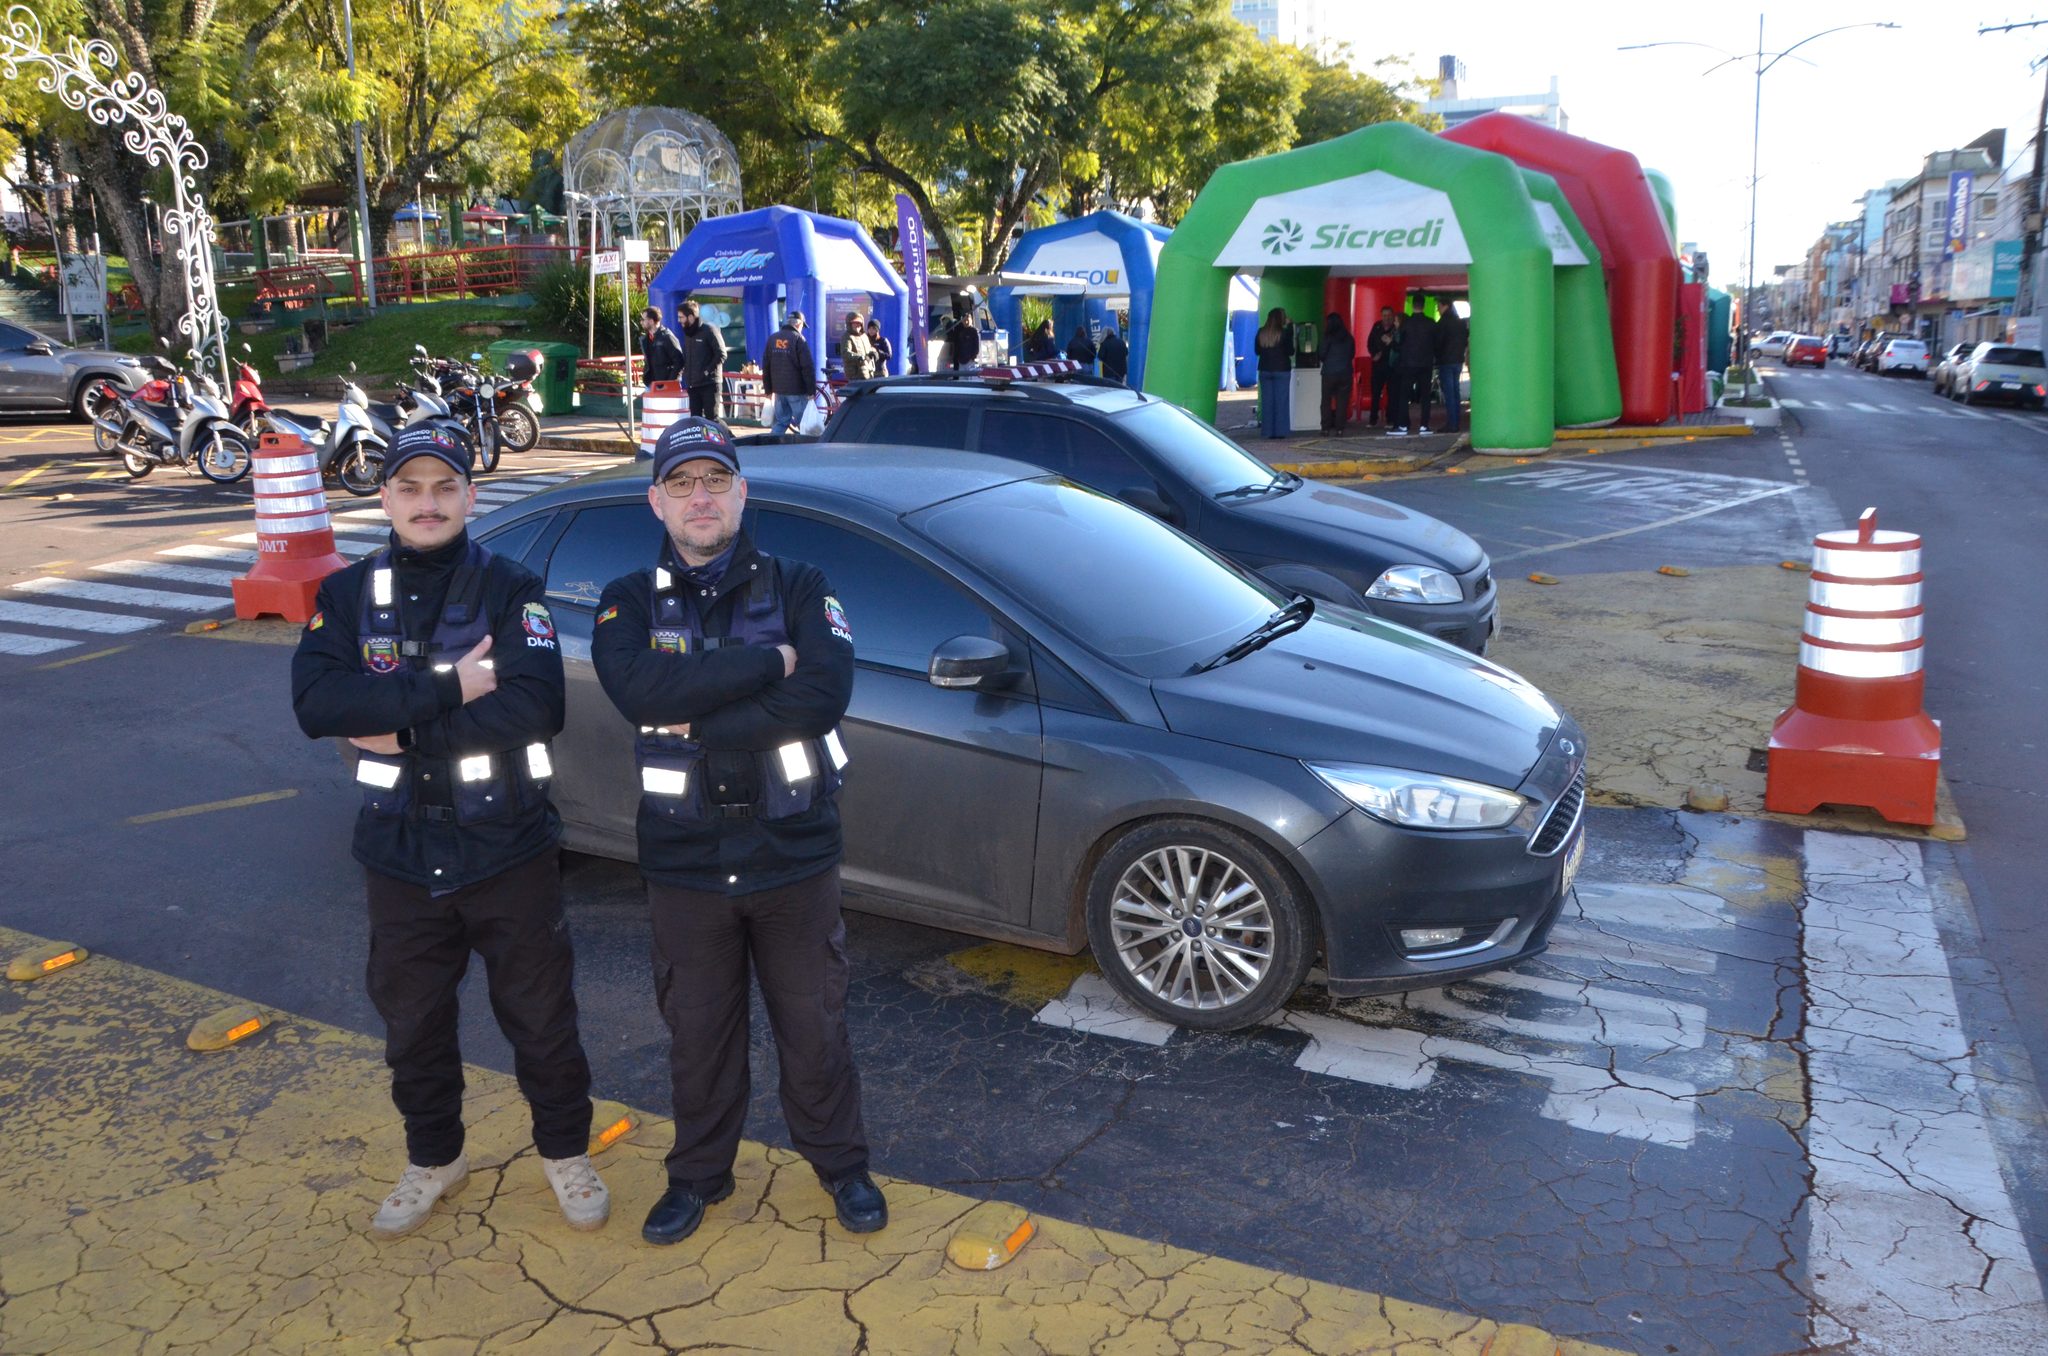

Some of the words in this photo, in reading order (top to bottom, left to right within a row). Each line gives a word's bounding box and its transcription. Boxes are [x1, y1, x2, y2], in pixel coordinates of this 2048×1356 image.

[1950, 177, 1969, 238] Colombo
[1310, 218, 1445, 250] Sicredi
[597, 254, 617, 264] TAXI
[696, 248, 775, 278] ecoflex
[726, 275, 749, 283] dormir
[748, 274, 763, 282] bem
[258, 540, 288, 553] DMT
[526, 636, 556, 650] DMT
[831, 627, 853, 644] DMT
